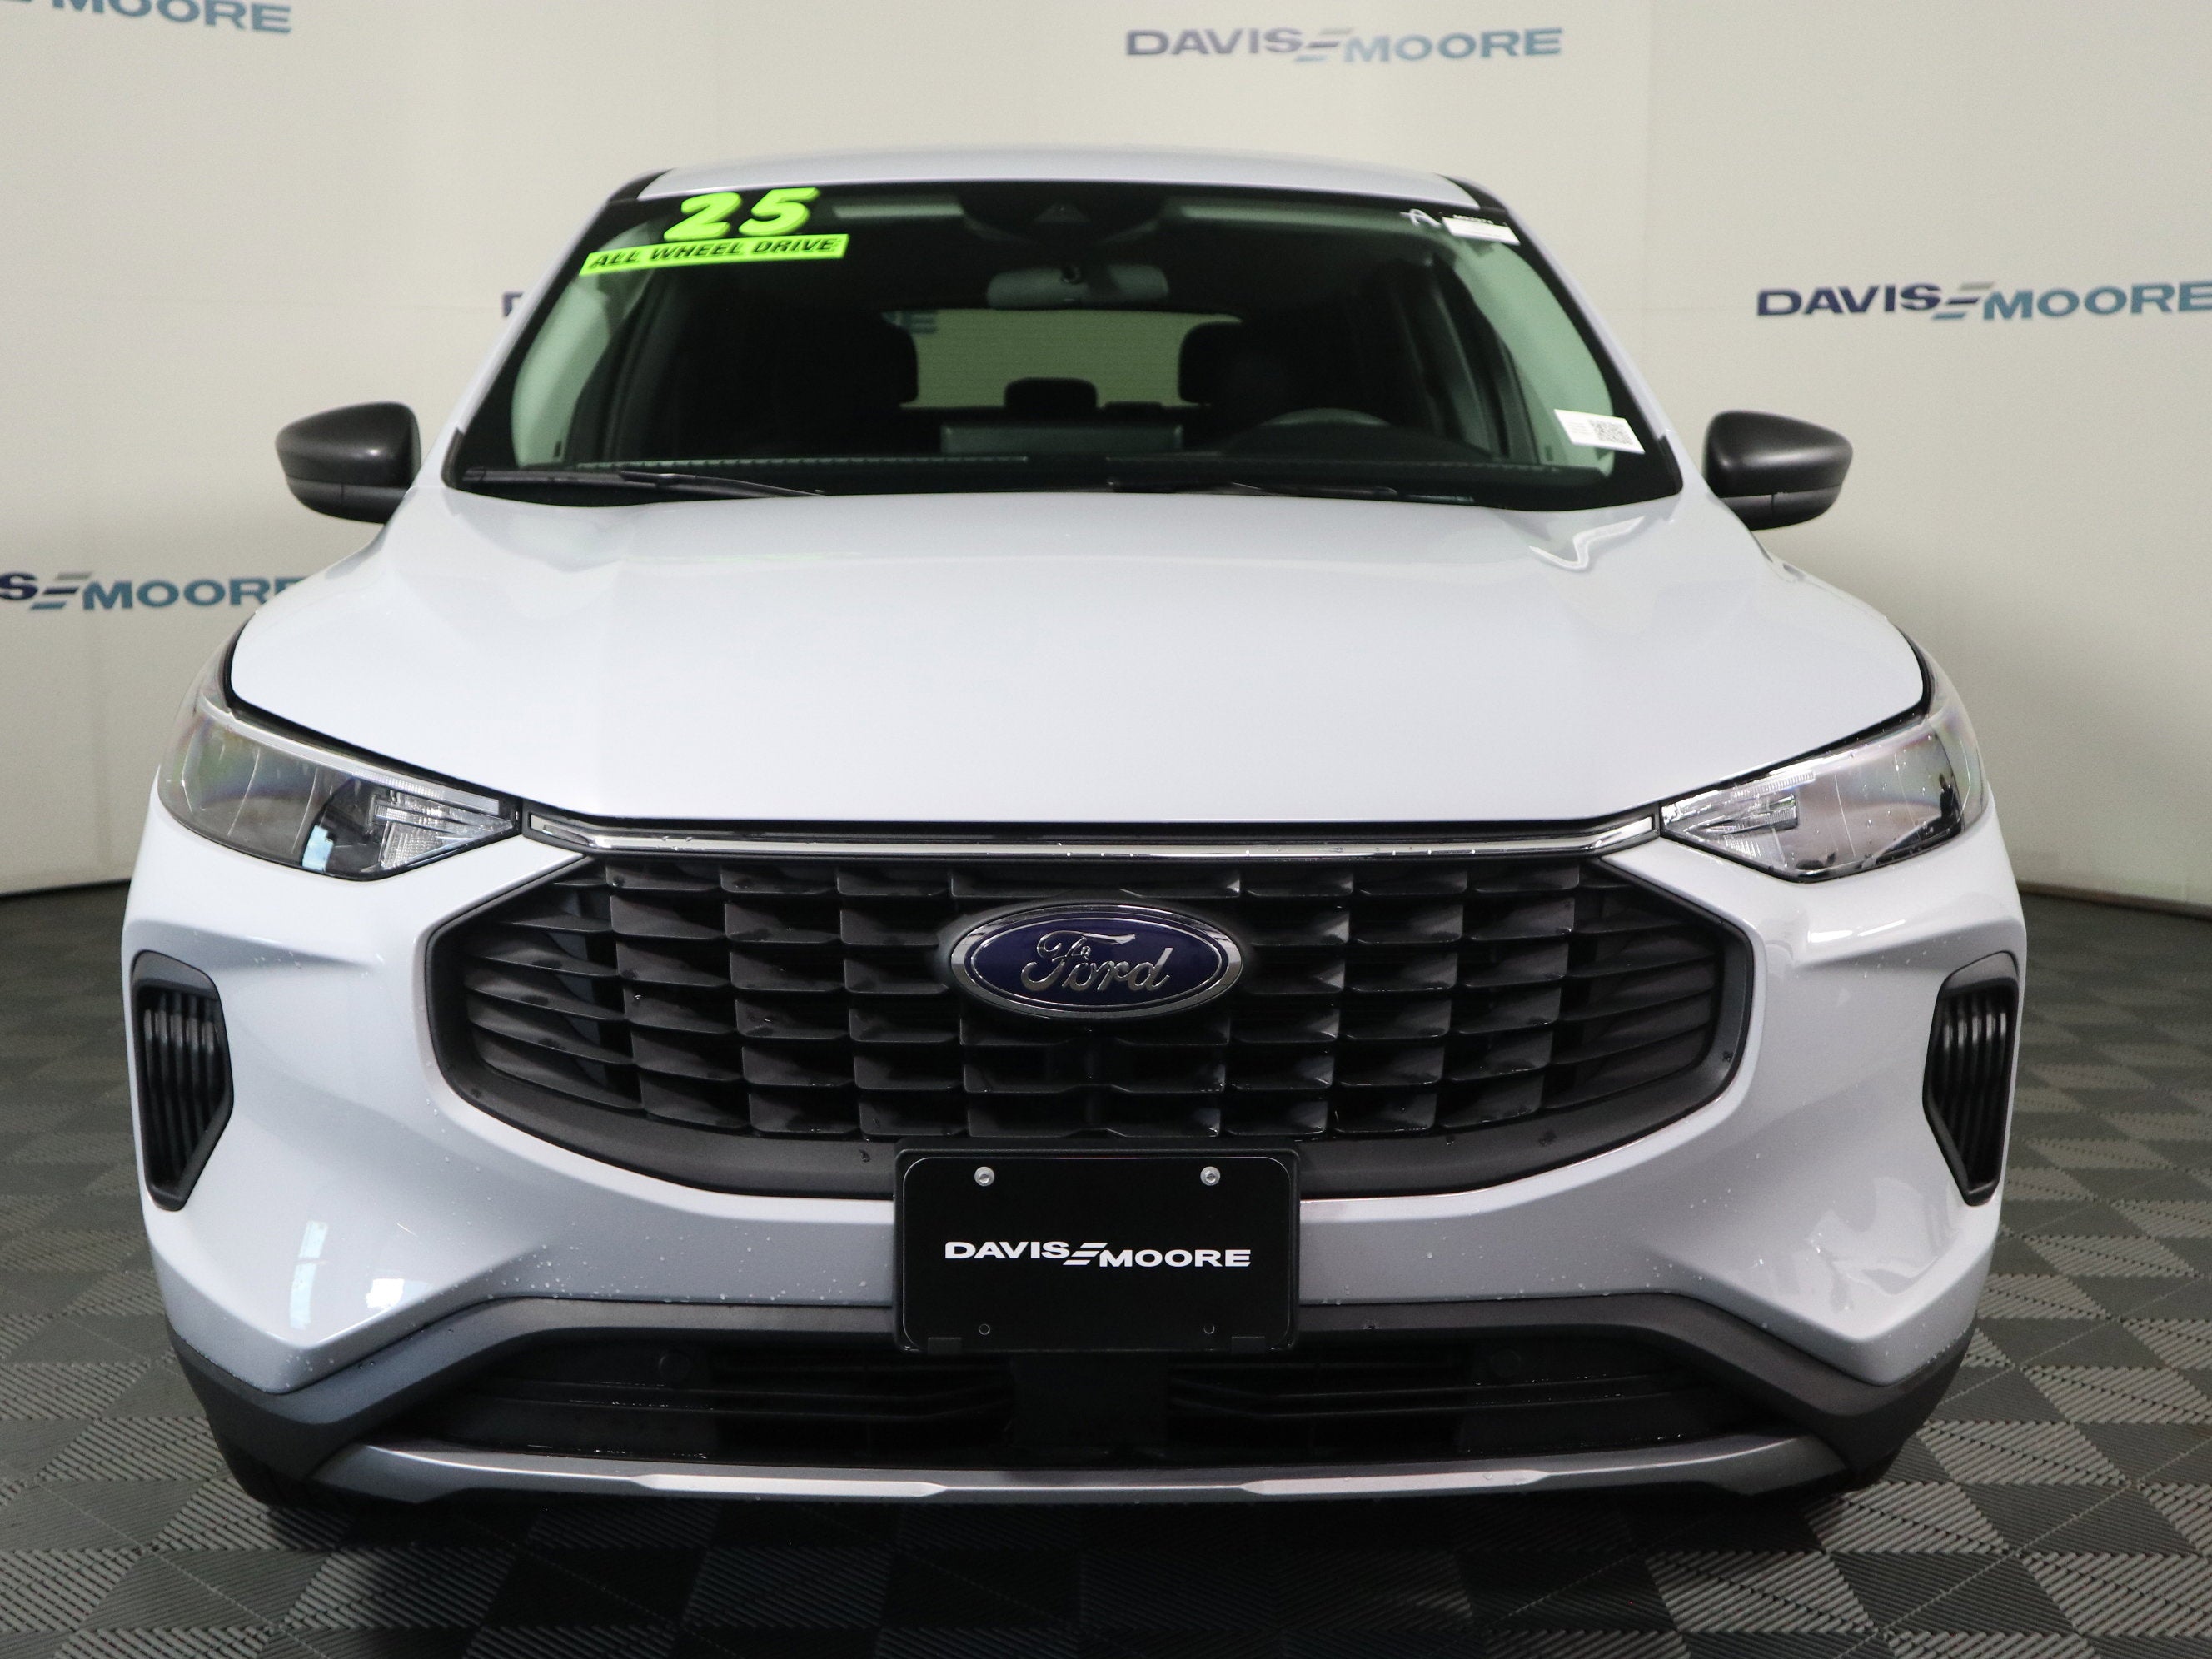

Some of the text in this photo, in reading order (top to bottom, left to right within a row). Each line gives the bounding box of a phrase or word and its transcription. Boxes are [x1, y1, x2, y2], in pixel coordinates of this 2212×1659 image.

[663, 187, 820, 242] 25
[589, 237, 838, 269] ALL WHEEL DRIVE
[1020, 929, 1173, 991] Ford
[944, 1241, 1251, 1268] DAVIS MOORE
